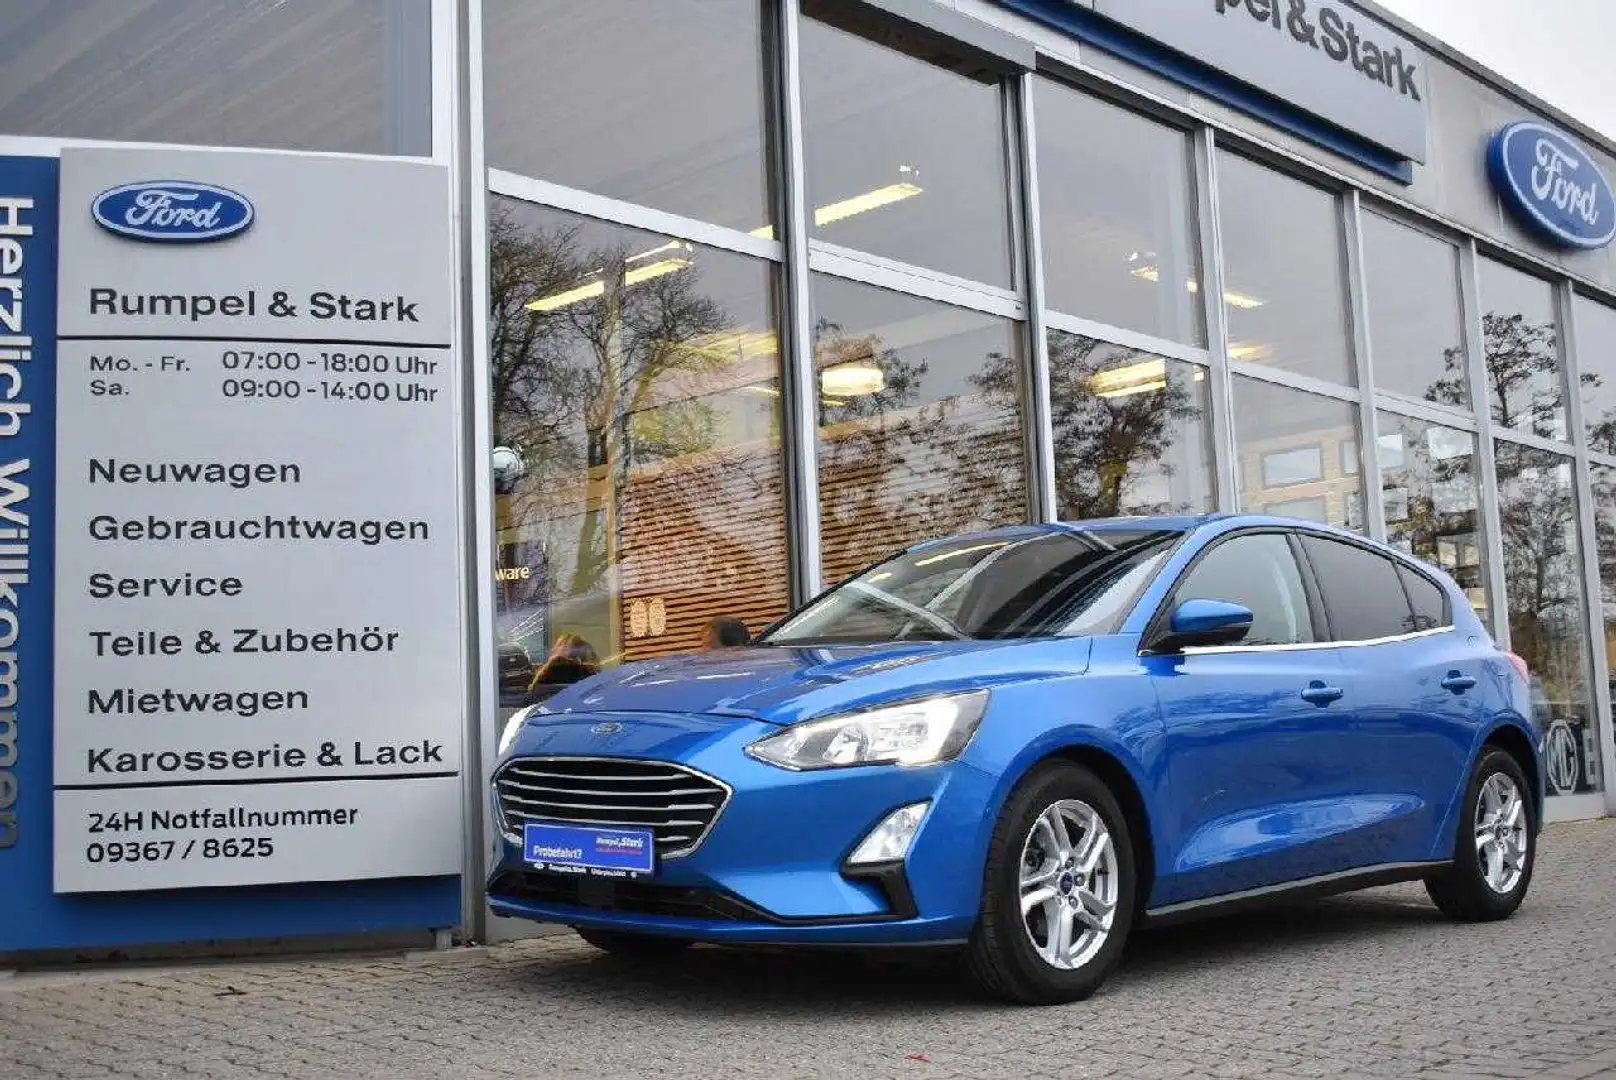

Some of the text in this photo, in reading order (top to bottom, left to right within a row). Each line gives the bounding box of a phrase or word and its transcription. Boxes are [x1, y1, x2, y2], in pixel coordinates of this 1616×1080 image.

[1530, 138, 1599, 227] Ford
[90, 288, 419, 323] Rumpel & Stark
[89, 355, 138, 372] Mo.
[161, 355, 191, 372] Fr.
[222, 350, 301, 371] 07:00
[320, 352, 390, 373] 18:00
[395, 355, 438, 375] Uhr
[90, 379, 130, 397] Sa.
[222, 378, 301, 399] 09:00
[320, 381, 390, 402] 14:00
[396, 383, 438, 402] Uhr
[89, 458, 301, 489] Neuwagen
[89, 515, 428, 546] Gebrauchtwagen
[89, 572, 243, 599] Service
[88, 626, 399, 657] Teile & Zubehör
[88, 688, 308, 718] Mietwagen
[88, 740, 444, 774] Karosserie & Lack
[88, 807, 358, 834] 24H Notfallnummer
[86, 837, 274, 863] 09367 / 8625
